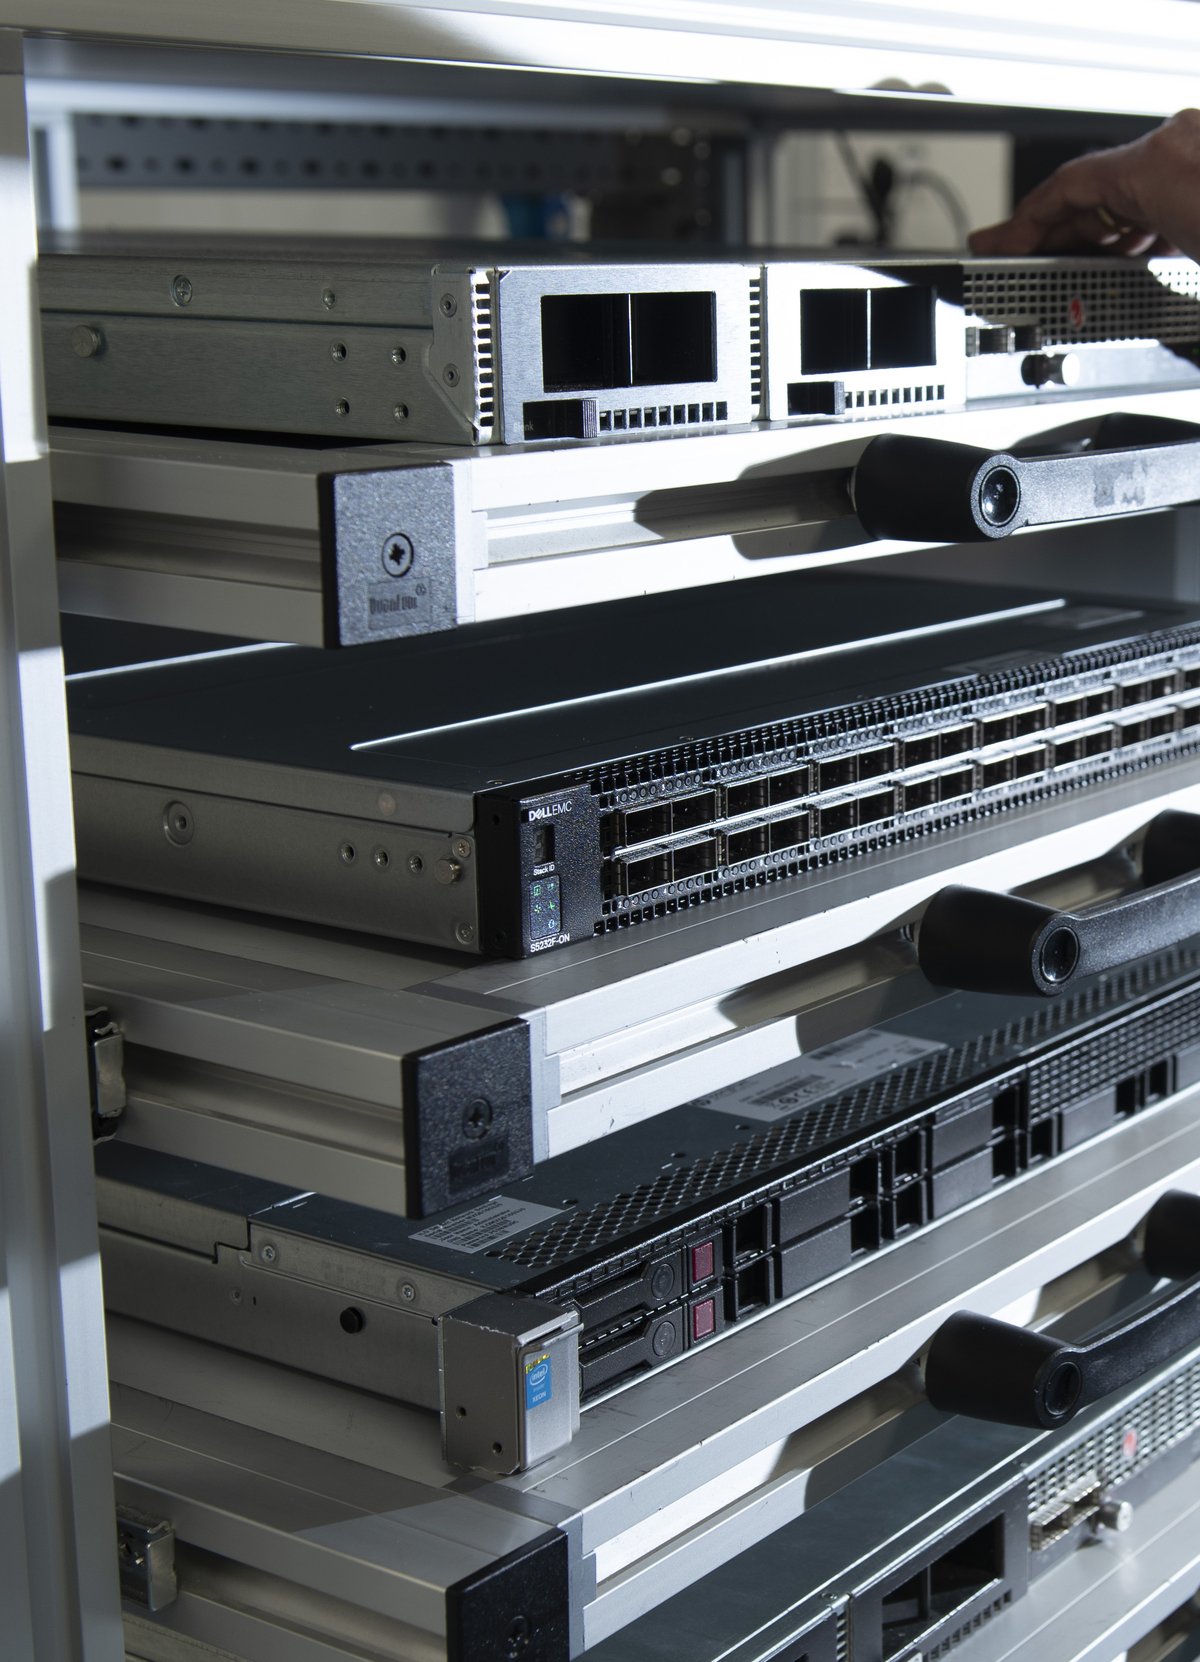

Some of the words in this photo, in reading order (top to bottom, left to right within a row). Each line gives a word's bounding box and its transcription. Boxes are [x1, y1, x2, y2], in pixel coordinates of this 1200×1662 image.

[533, 865, 549, 876] Stack
[548, 864, 555, 872] ID
[530, 932, 570, 953] S5232F-ON
[531, 1367, 546, 1381] intel
